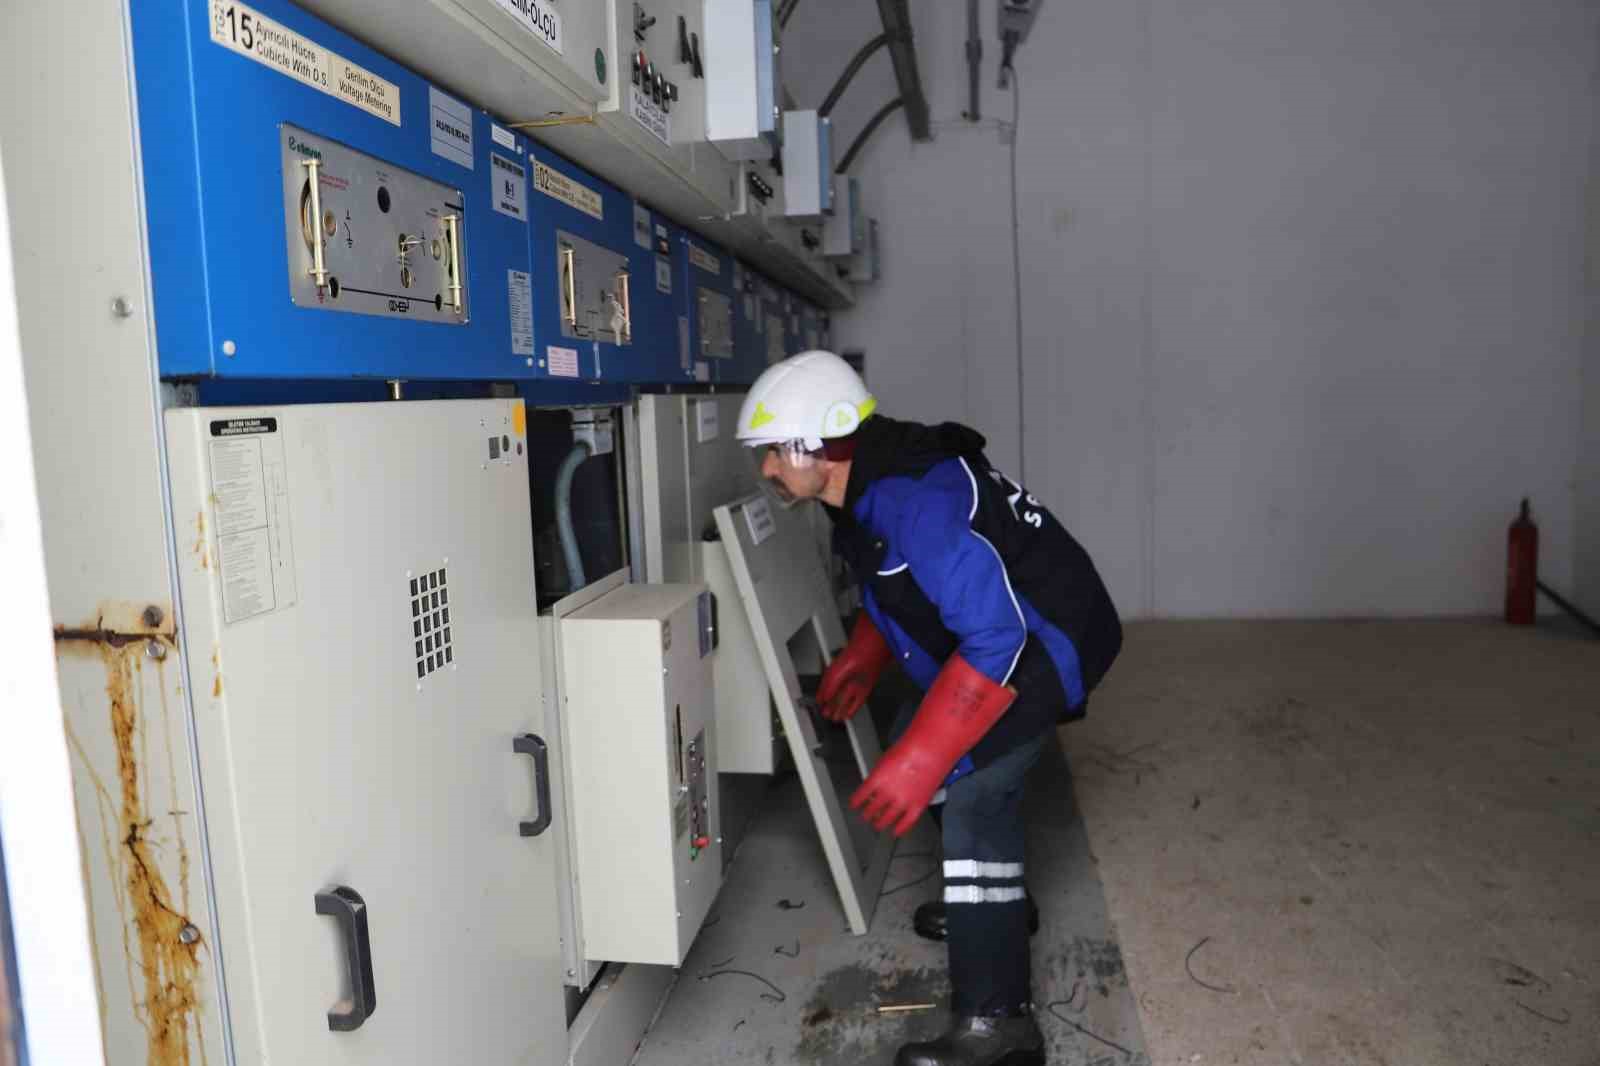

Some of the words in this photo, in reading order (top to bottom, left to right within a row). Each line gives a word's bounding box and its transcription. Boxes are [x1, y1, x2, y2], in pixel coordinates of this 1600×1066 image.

[226, 6, 254, 49] 15
[256, 41, 290, 68] Cubicle
[292, 55, 311, 79] With
[339, 79, 365, 103] Voltage
[364, 90, 392, 117] Metering
